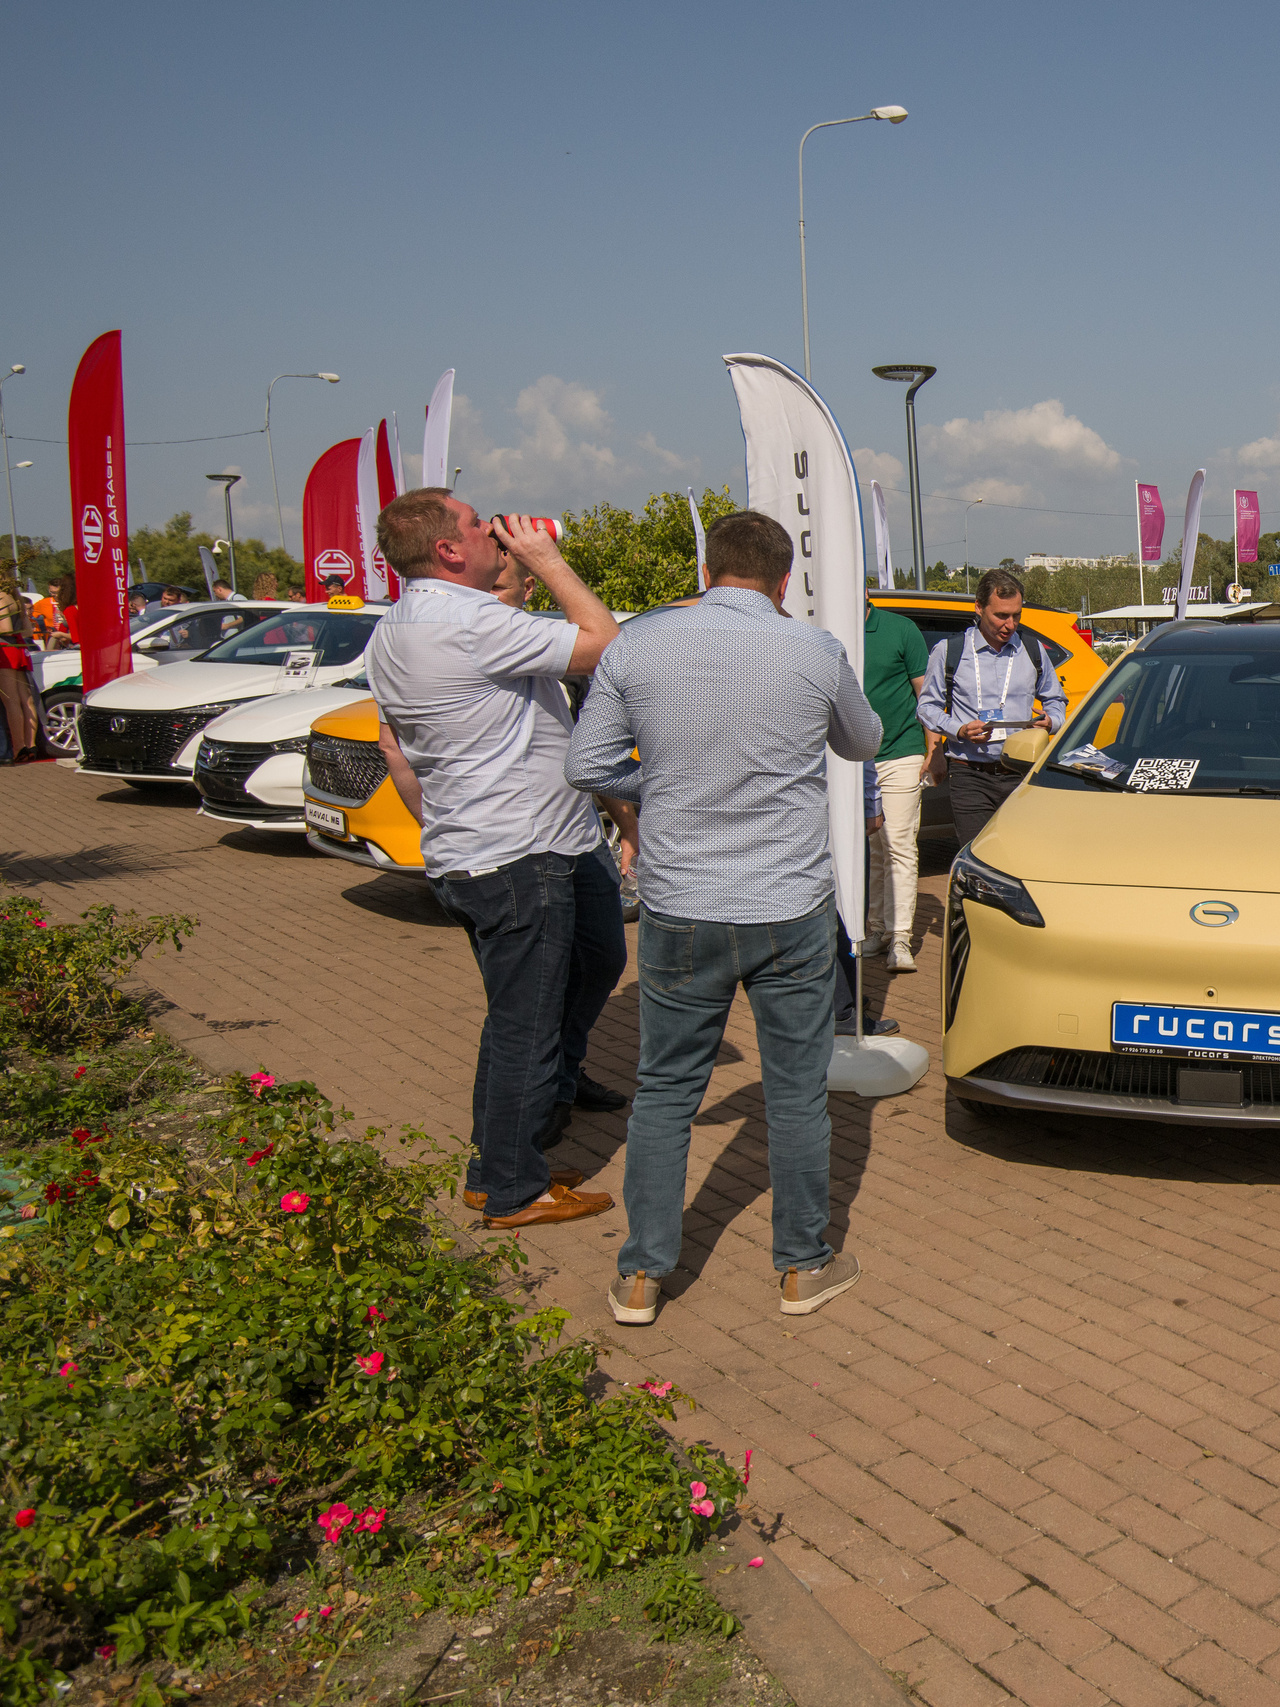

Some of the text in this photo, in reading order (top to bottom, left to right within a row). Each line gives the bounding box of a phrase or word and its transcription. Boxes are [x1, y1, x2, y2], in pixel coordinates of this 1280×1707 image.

[106, 435, 120, 538] GARAGES
[83, 510, 102, 558] MG
[1162, 586, 1209, 604] ЦВТЫ
[309, 808, 330, 822] HAVAL
[1187, 1050, 1230, 1059] rucars
